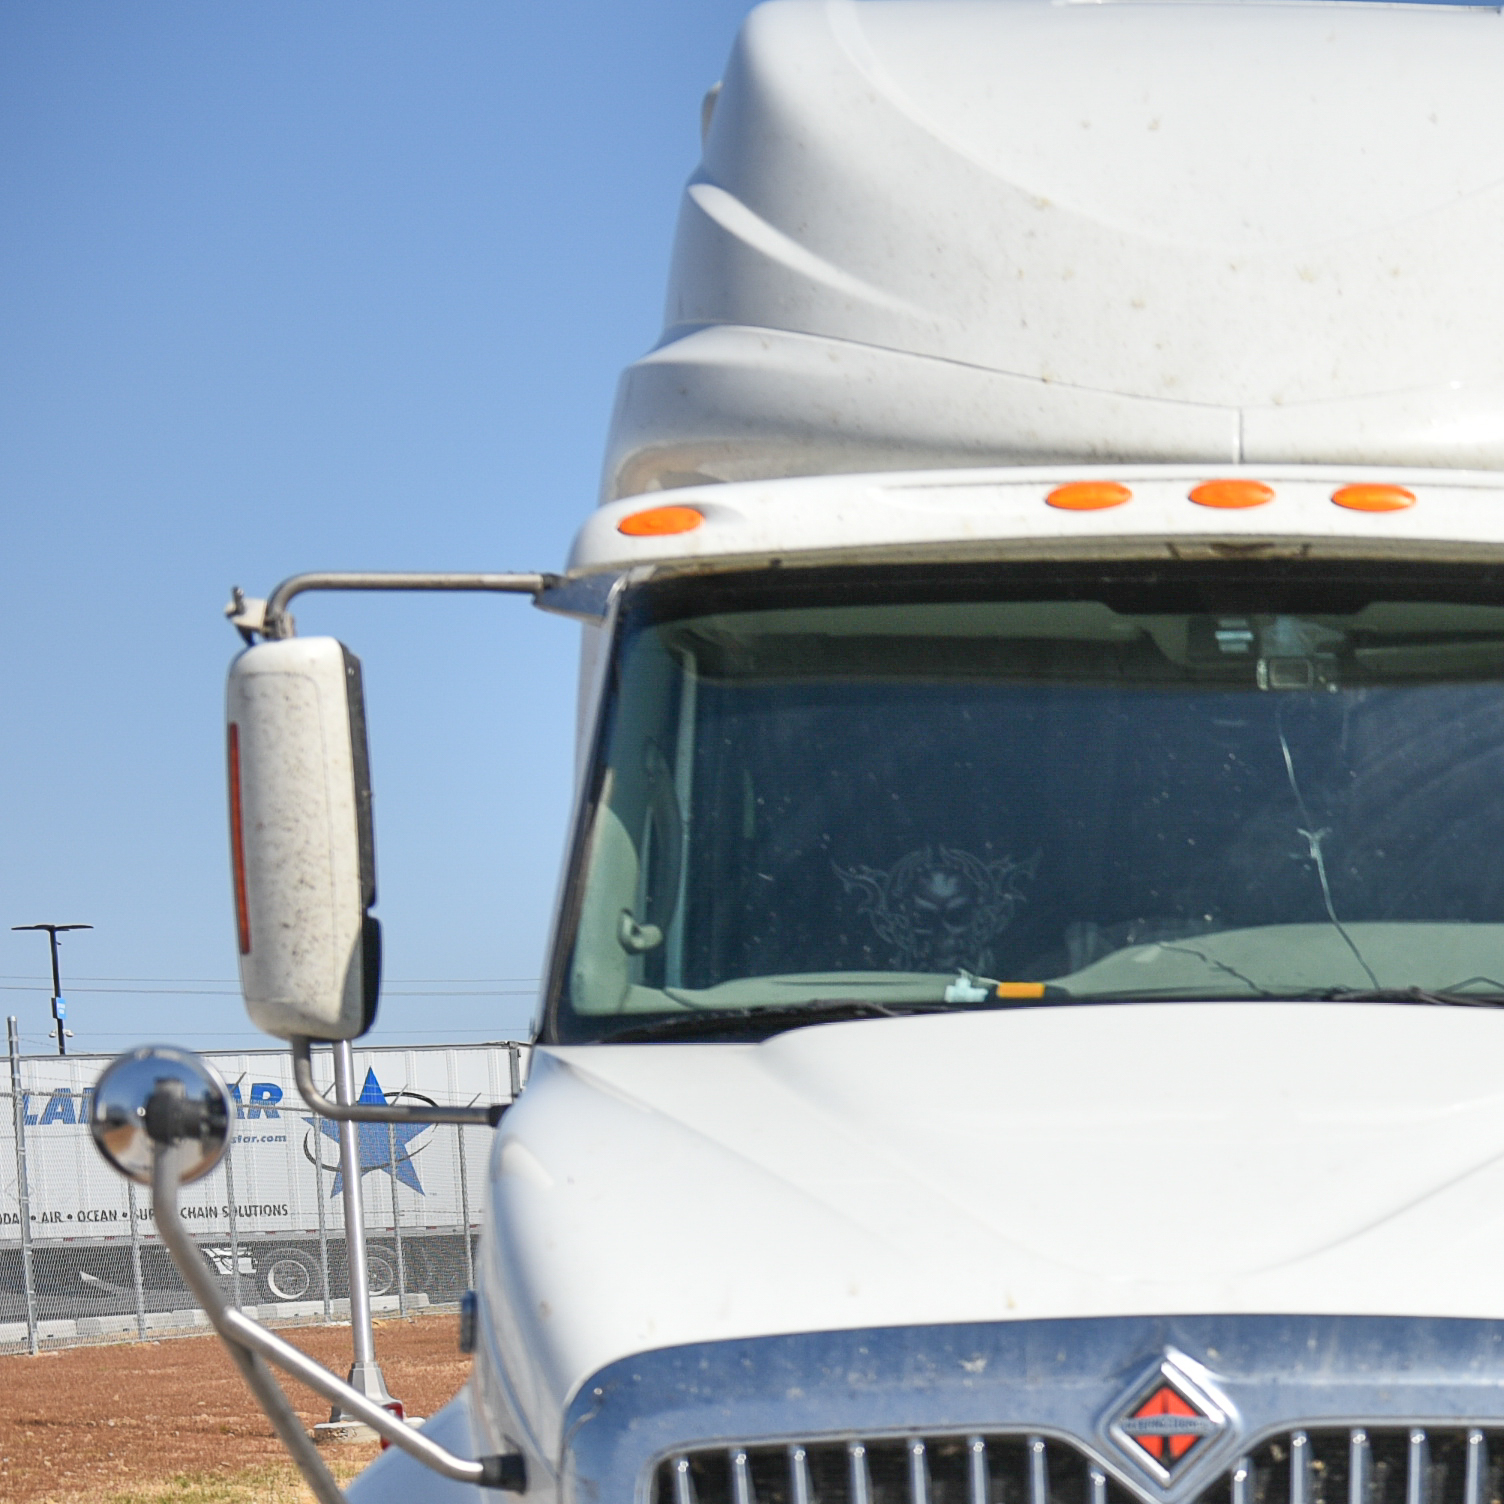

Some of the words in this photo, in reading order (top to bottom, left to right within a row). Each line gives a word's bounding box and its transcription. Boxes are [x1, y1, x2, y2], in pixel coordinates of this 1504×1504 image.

[41, 1211, 62, 1223] AIR
[77, 1209, 117, 1222] OCEAN
[180, 1206, 218, 1219] CHAIN
